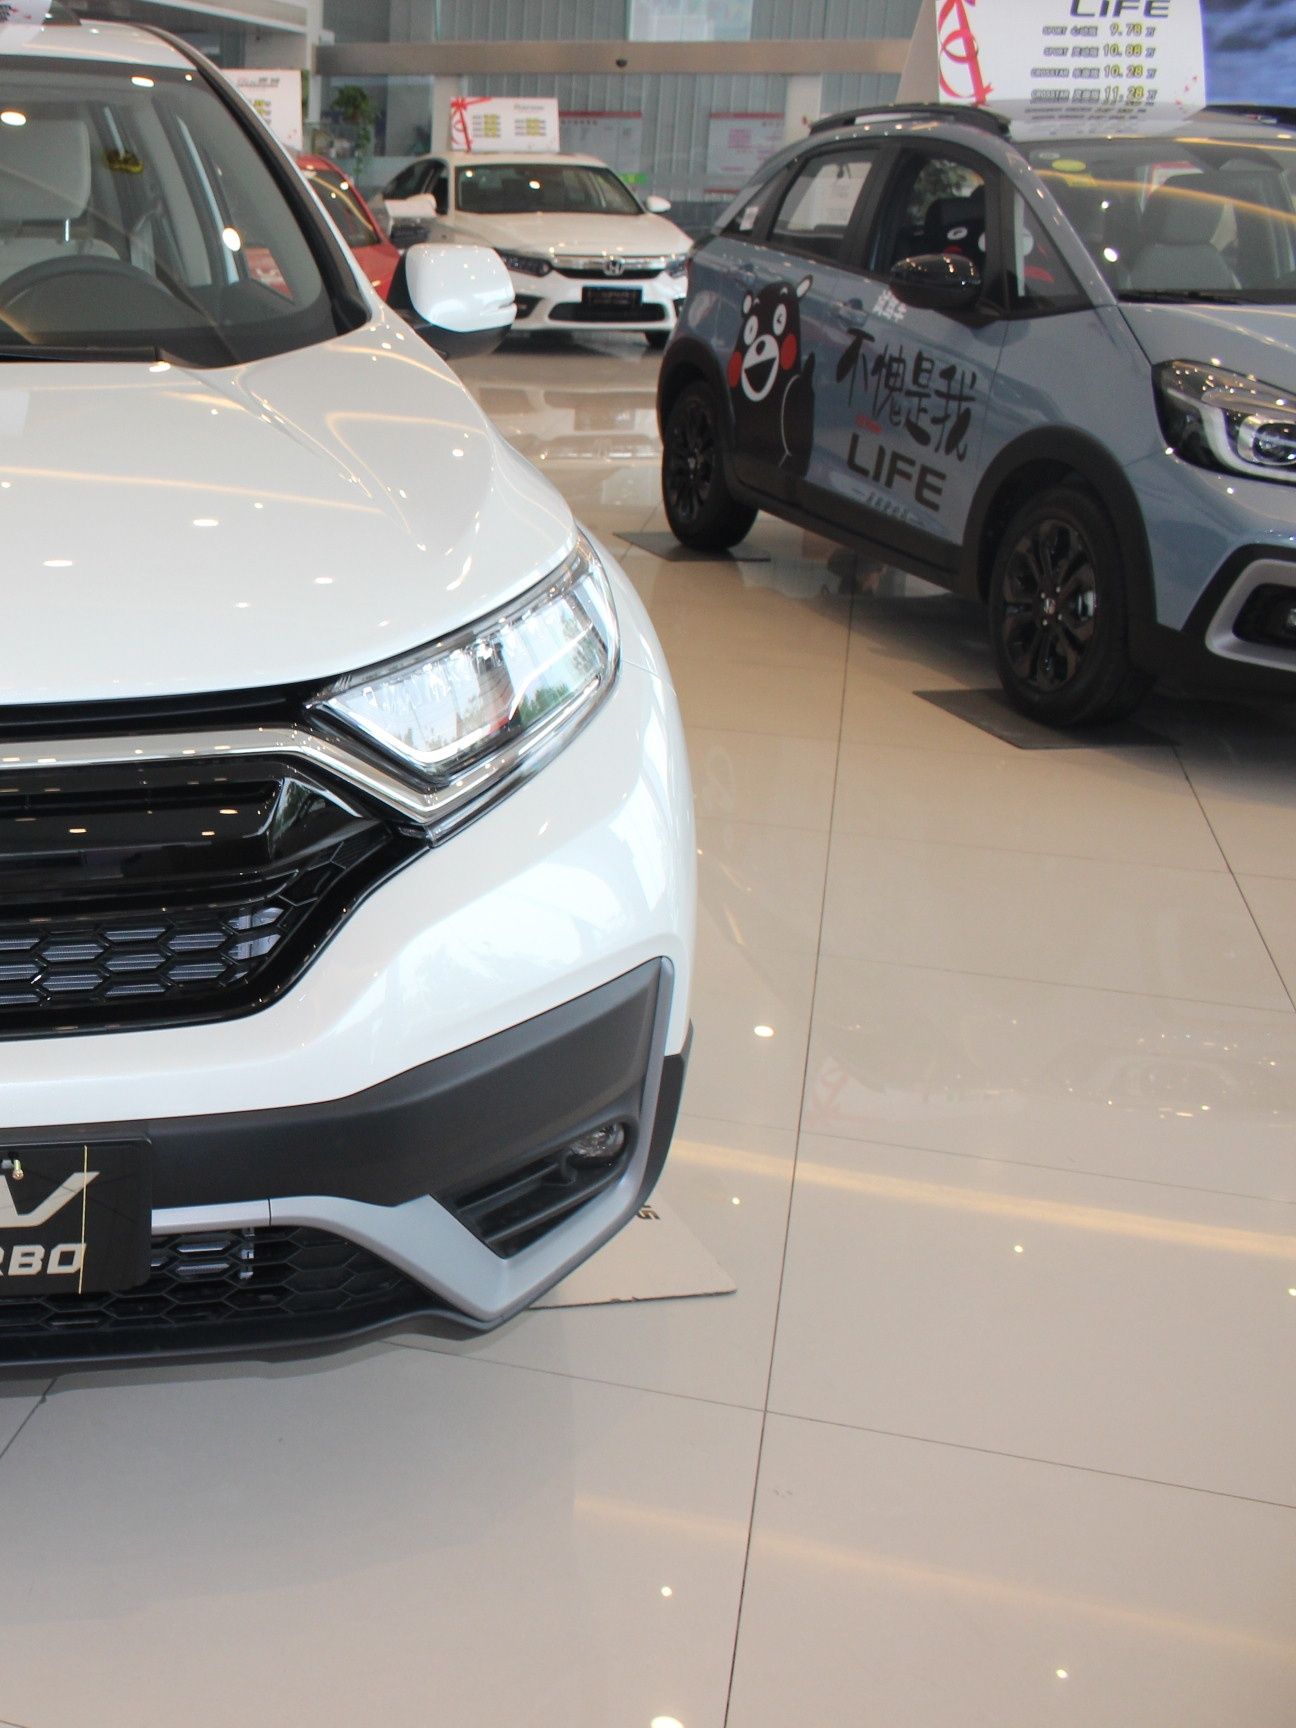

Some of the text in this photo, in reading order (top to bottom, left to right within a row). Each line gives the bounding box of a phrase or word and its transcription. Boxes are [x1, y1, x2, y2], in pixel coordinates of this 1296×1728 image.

[1070, 0, 1170, 17] LIFE
[836, 328, 978, 462] 不愧是我
[847, 432, 947, 513] LIFE
